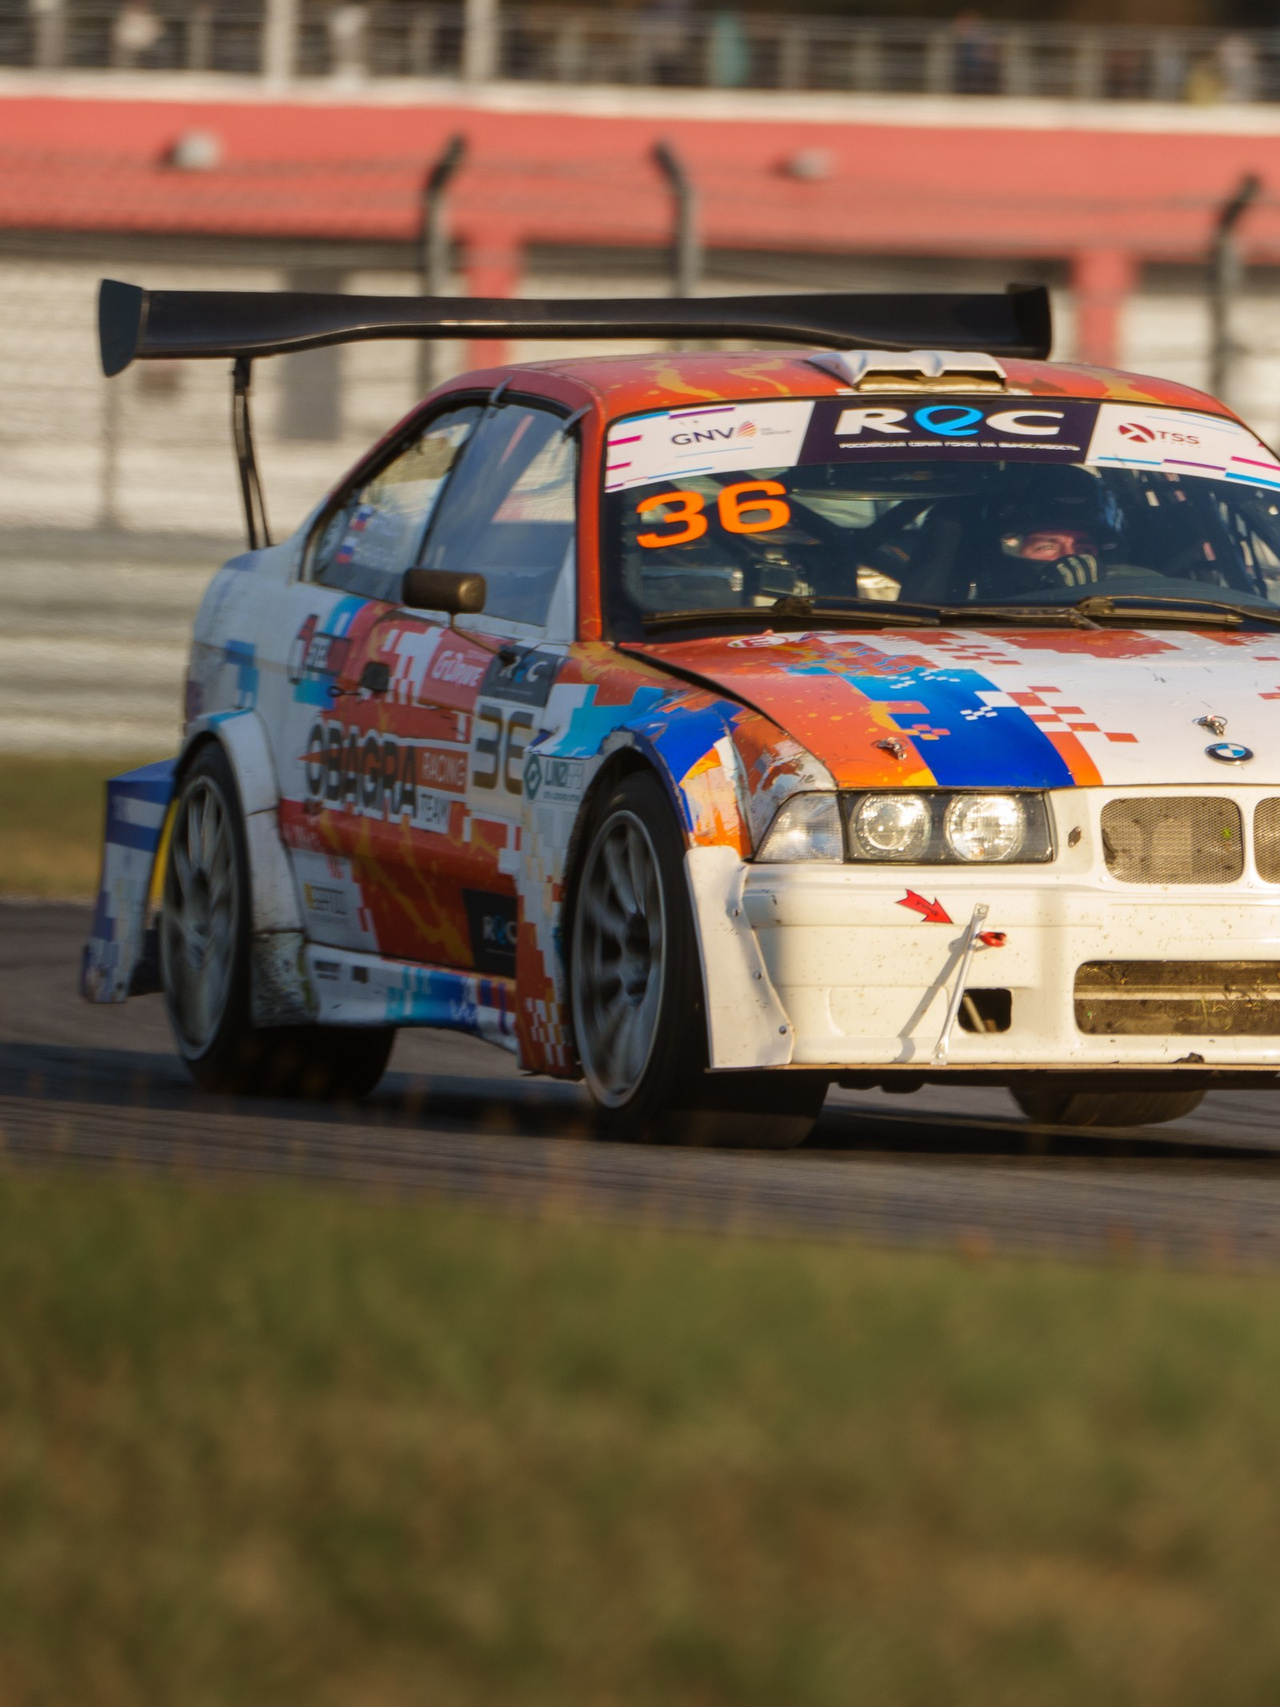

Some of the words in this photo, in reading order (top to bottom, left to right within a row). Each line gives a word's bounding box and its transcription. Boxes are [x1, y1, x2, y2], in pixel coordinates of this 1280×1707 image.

[671, 427, 735, 446] GNV
[1157, 430, 1201, 446] TSS
[635, 479, 791, 549] 36
[421, 751, 467, 788] RACING
[420, 793, 449, 826] TEAM
